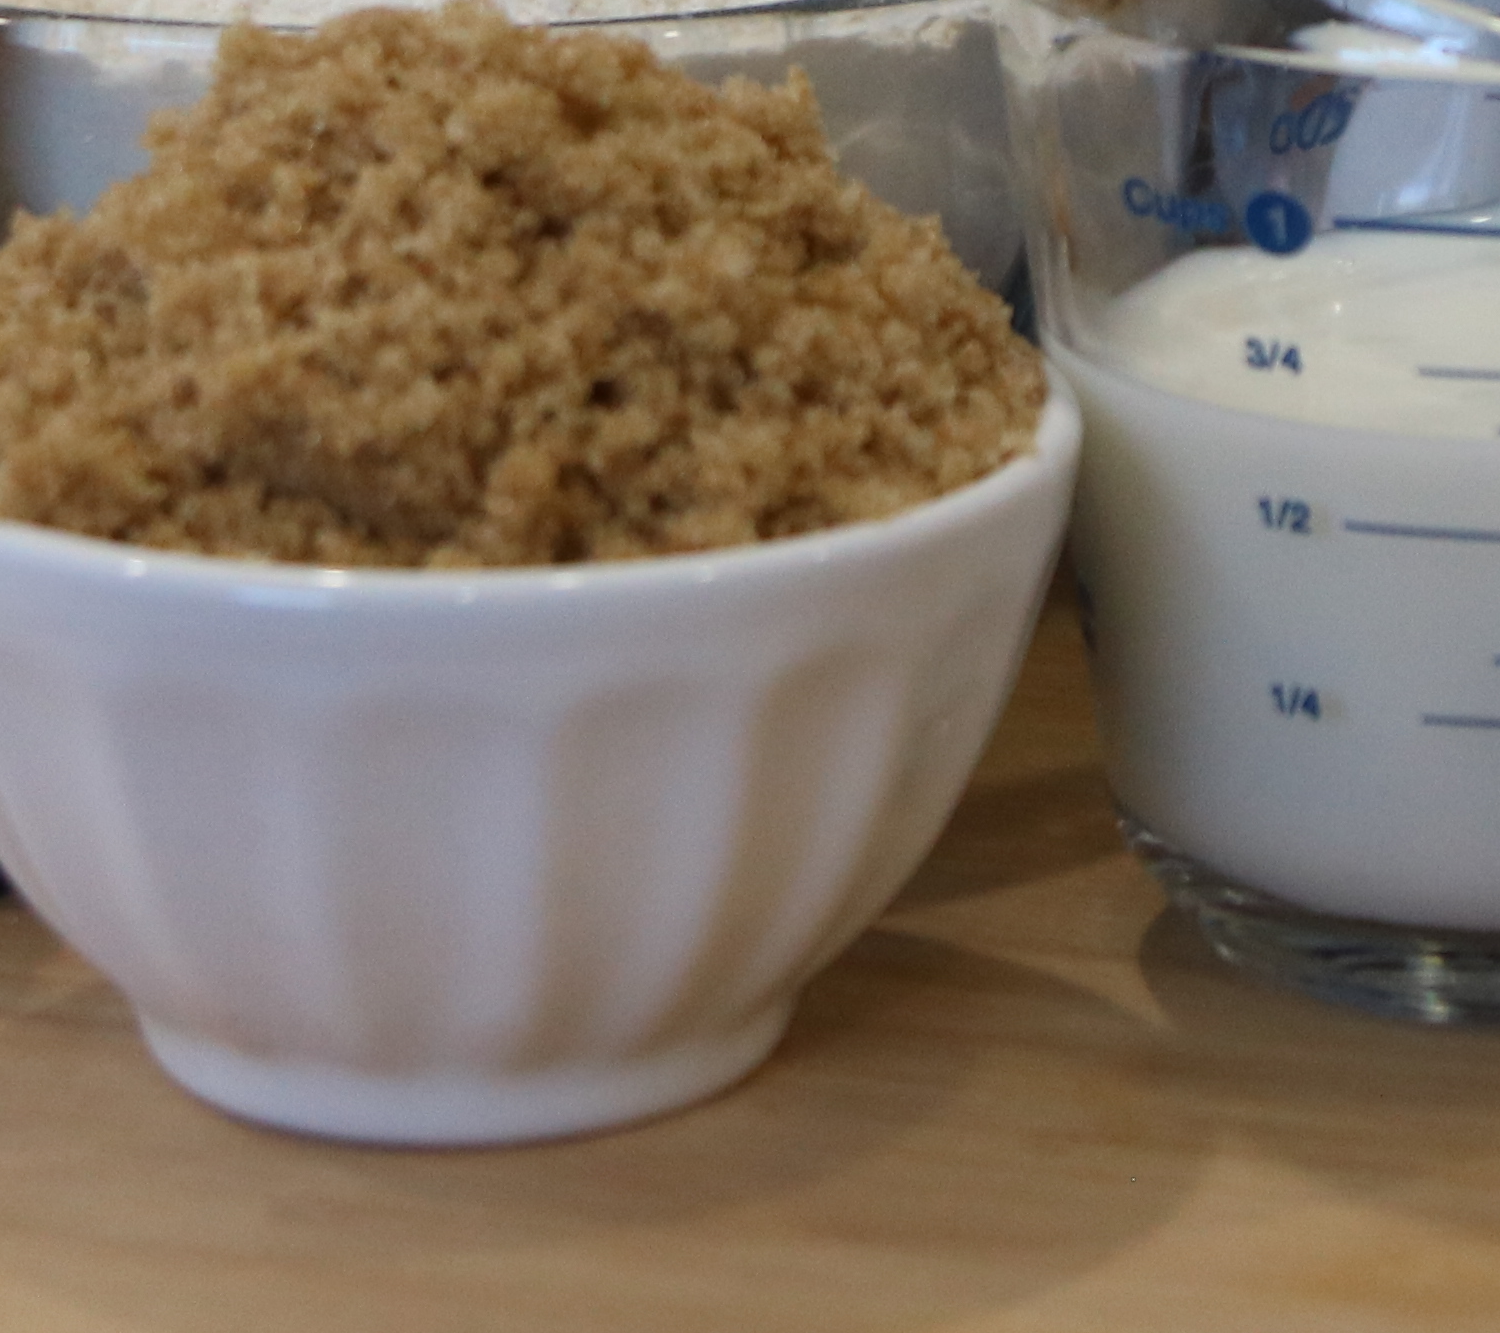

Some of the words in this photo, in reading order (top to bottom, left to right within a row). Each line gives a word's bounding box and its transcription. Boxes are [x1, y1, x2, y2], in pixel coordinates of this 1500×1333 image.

[1245, 337, 1304, 374] 3/4
[1258, 496, 1313, 536] 1/2
[1270, 682, 1321, 722] 1/4
